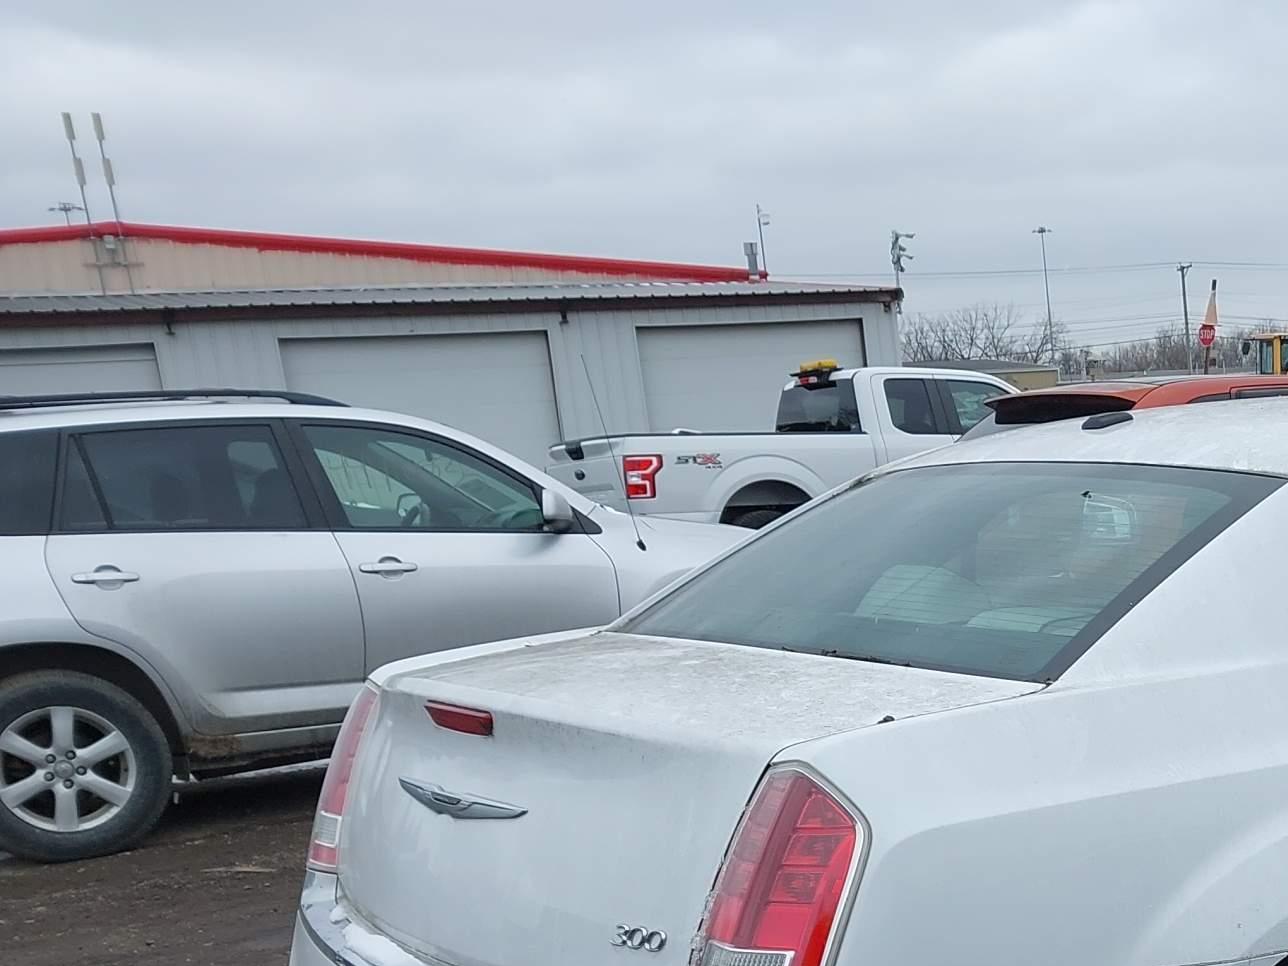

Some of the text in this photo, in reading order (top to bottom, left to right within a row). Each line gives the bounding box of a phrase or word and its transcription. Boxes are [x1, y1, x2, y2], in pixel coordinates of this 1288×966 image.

[1200, 329, 1215, 339] STOP
[674, 453, 722, 465] STX
[608, 924, 667, 953] 300
